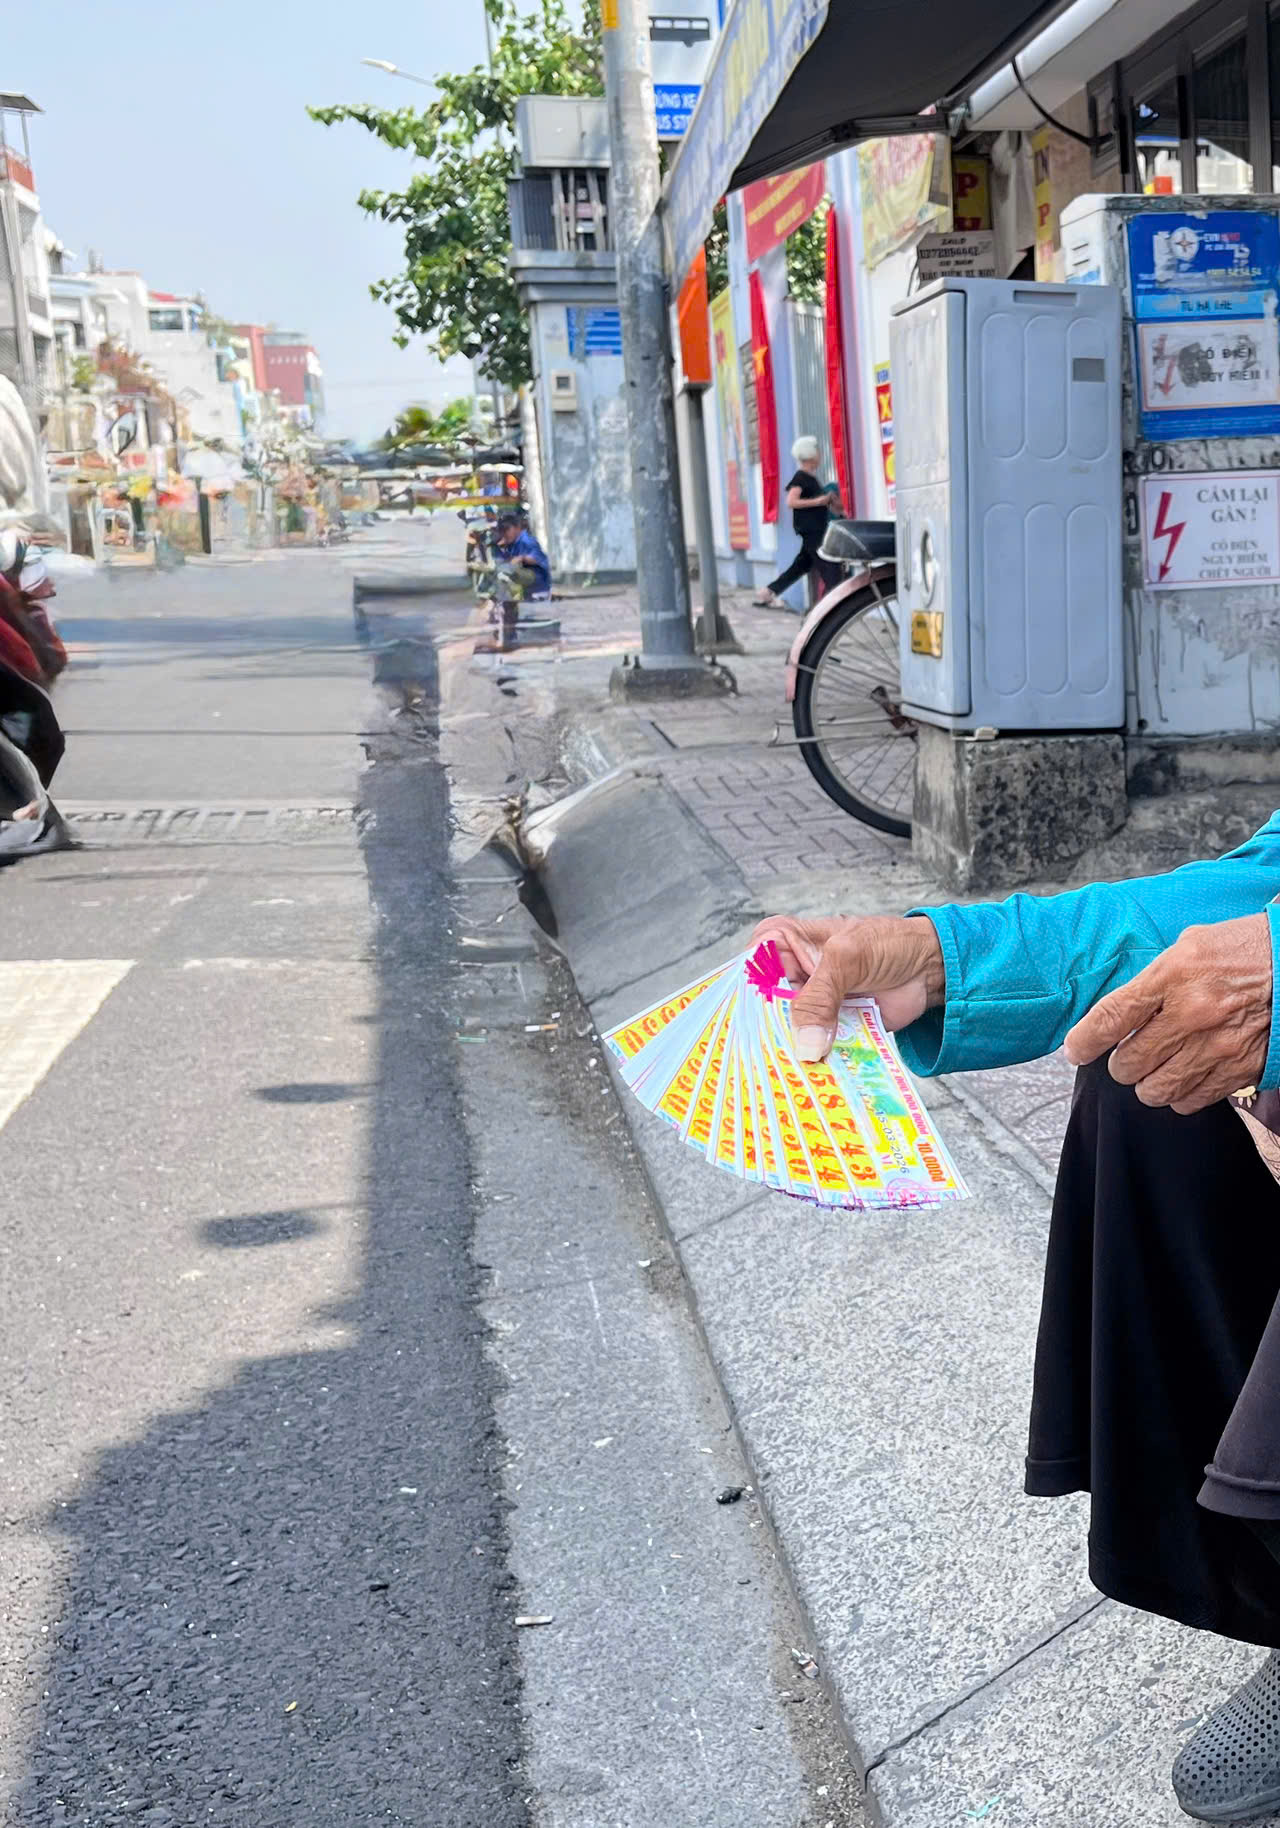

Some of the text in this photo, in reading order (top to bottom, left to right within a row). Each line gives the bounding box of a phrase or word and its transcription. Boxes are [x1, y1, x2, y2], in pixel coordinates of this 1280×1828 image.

[655, 89, 680, 108] ỪNG
[656, 113, 672, 130] US
[1197, 485, 1268, 504] CẤM LẠI
[803, 1058, 877, 1183] 58743
